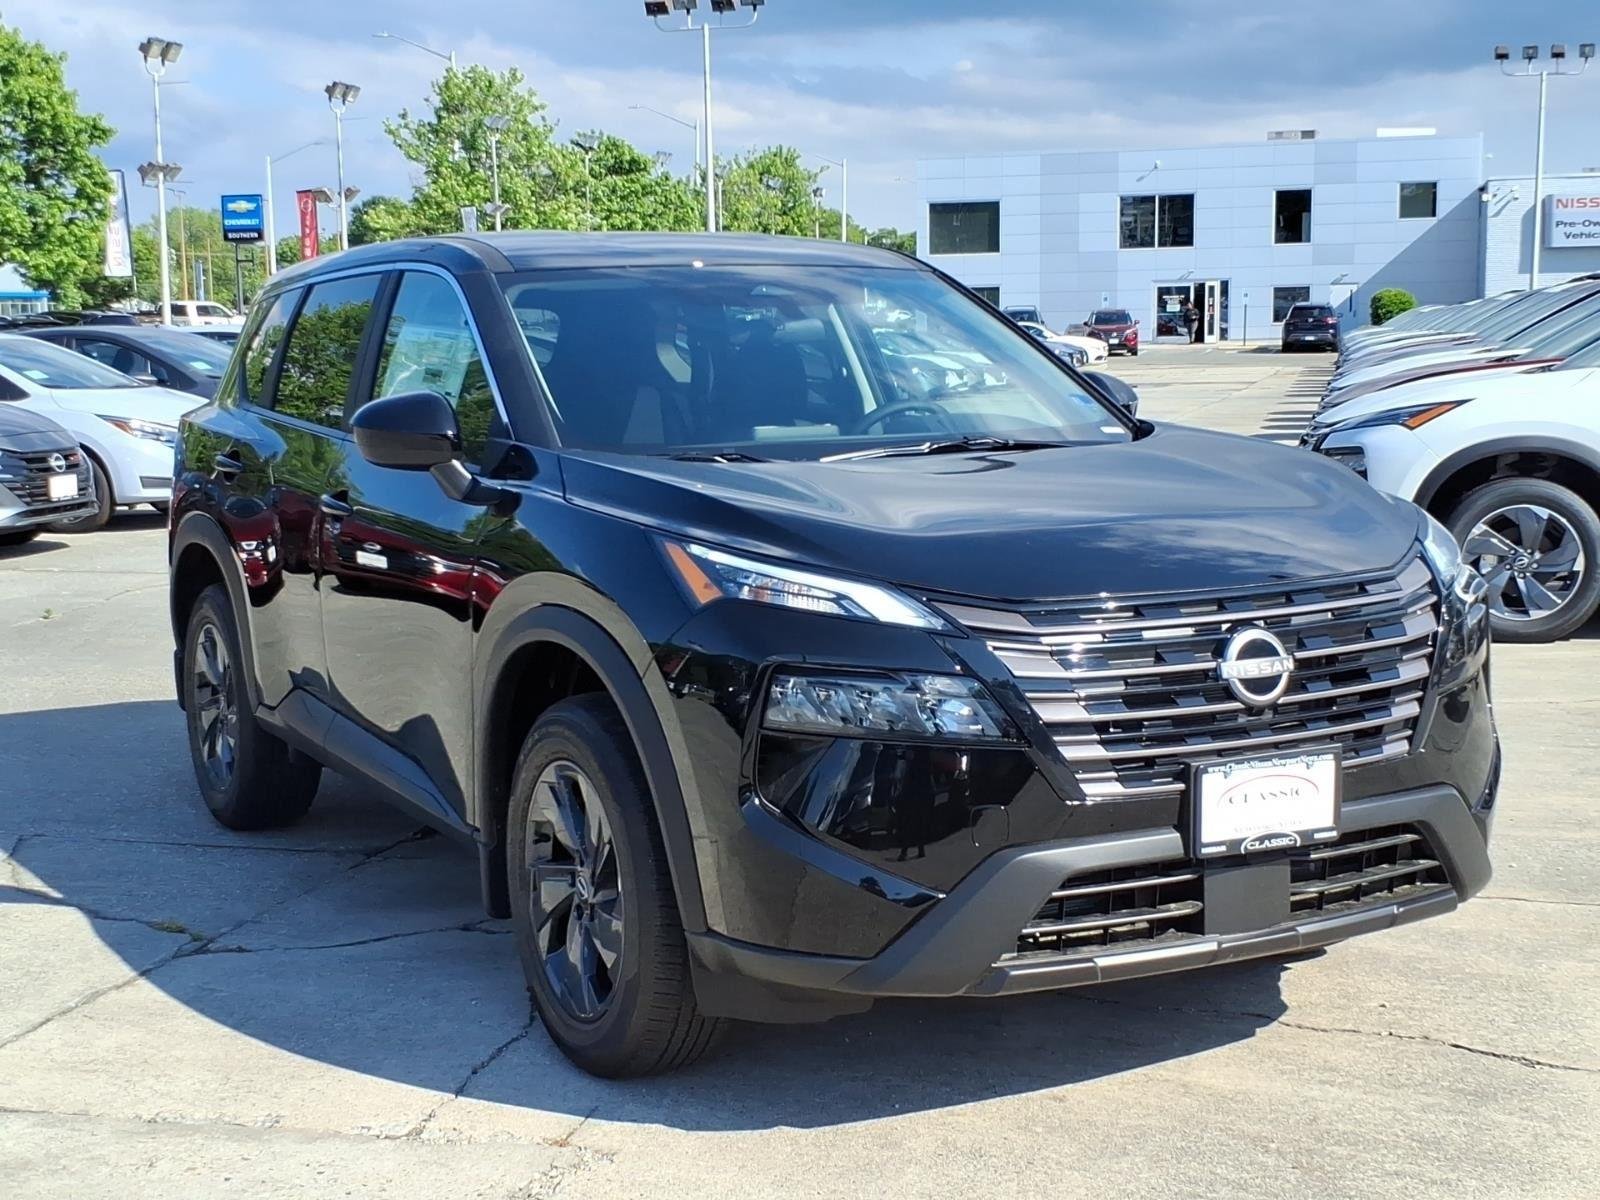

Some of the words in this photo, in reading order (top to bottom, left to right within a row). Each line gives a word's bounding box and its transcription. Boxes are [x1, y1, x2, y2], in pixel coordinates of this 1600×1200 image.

[1556, 197, 1600, 209] NISS
[1225, 658, 1294, 676] NISSAN
[1246, 836, 1295, 849] CLASSIC
